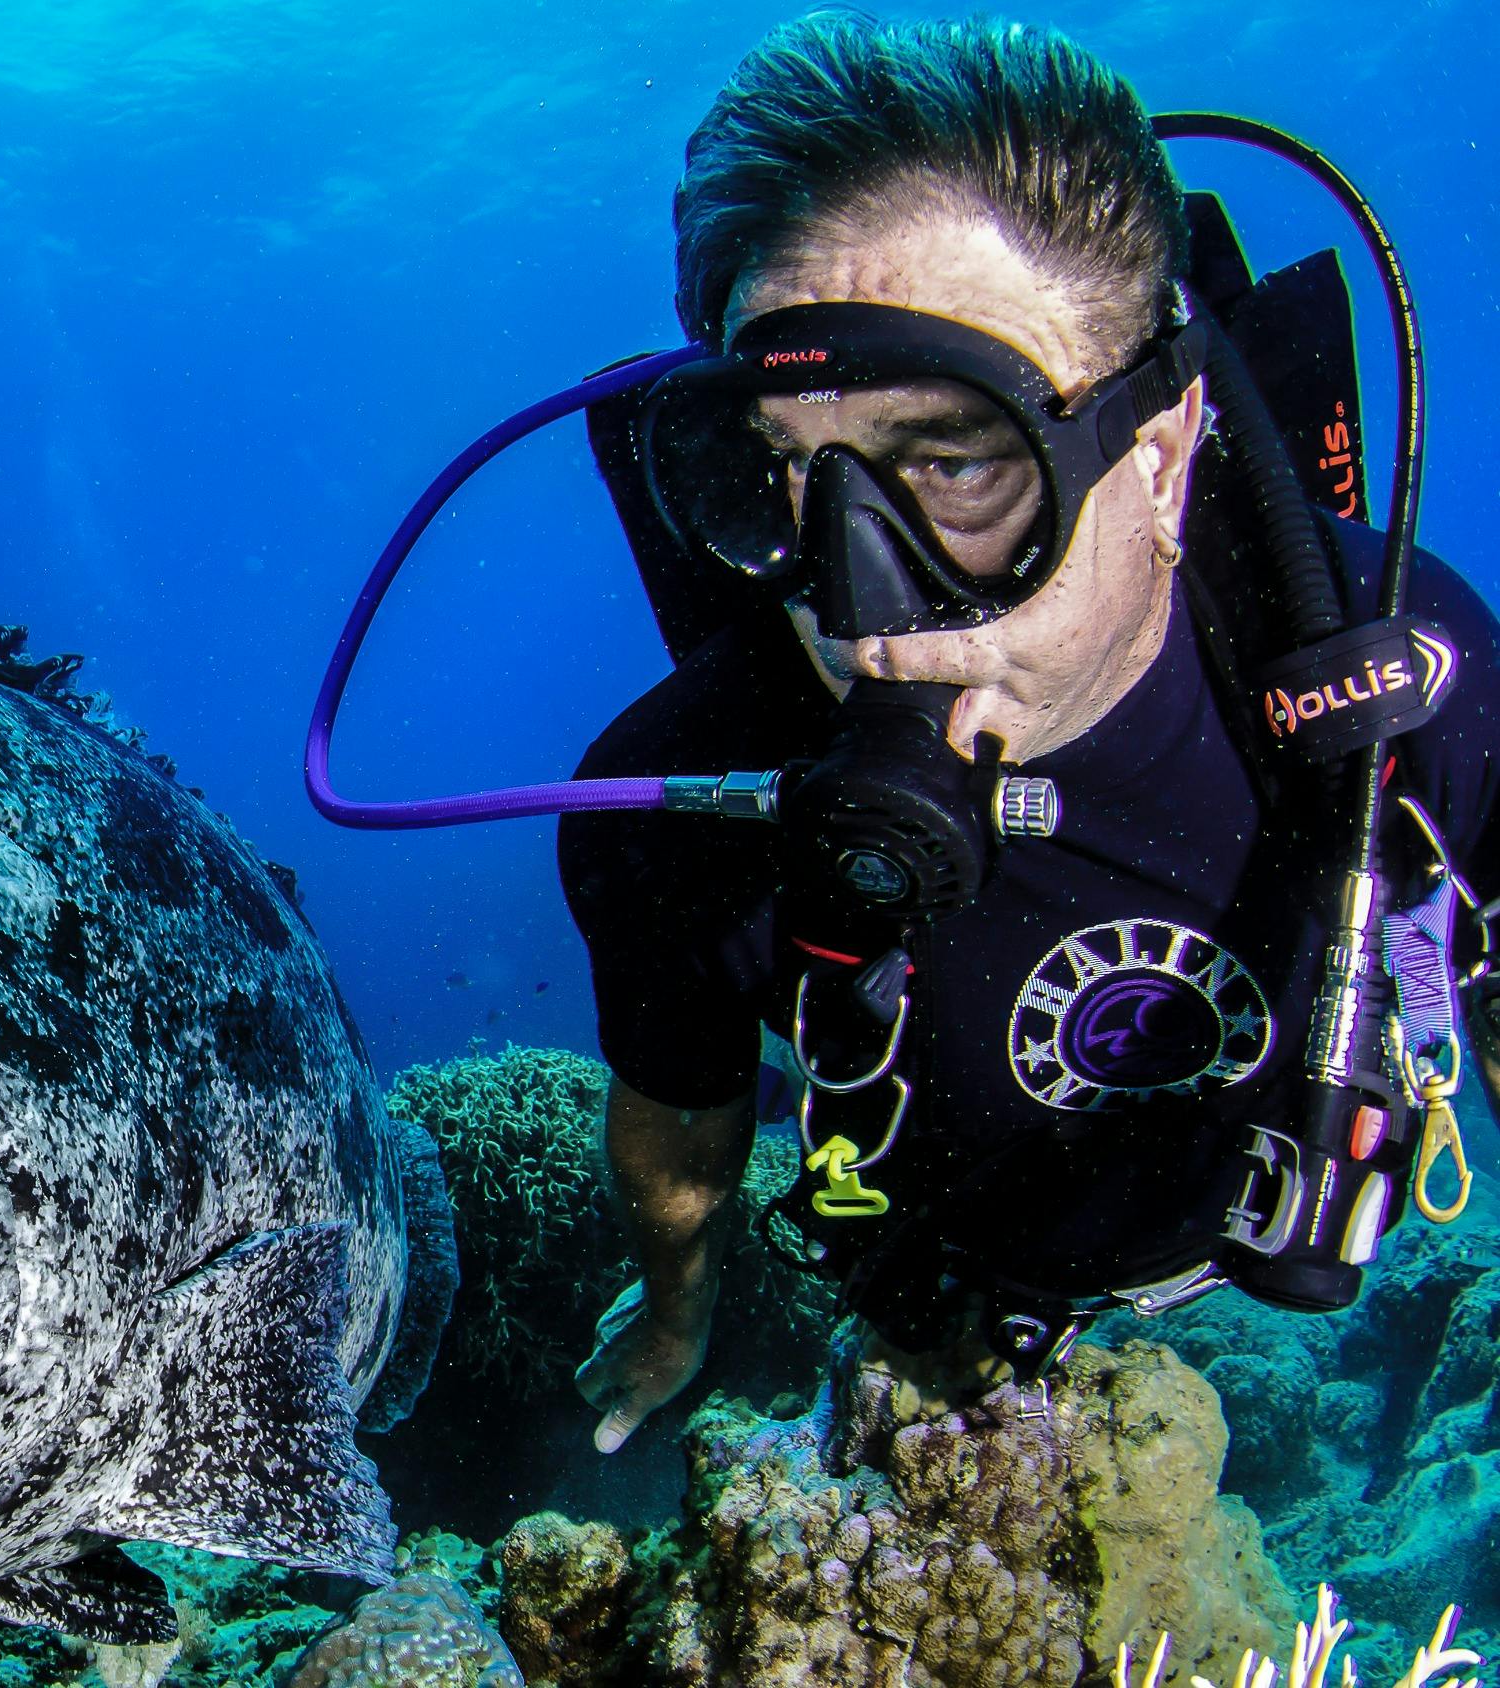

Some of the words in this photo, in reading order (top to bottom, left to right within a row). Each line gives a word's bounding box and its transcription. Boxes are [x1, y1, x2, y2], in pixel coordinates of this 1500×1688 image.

[798, 390, 840, 404] ONYX
[1319, 421, 1356, 519] LLIS
[1265, 659, 1404, 737] HOLLIS
[1017, 922, 1248, 1015] BALIN
